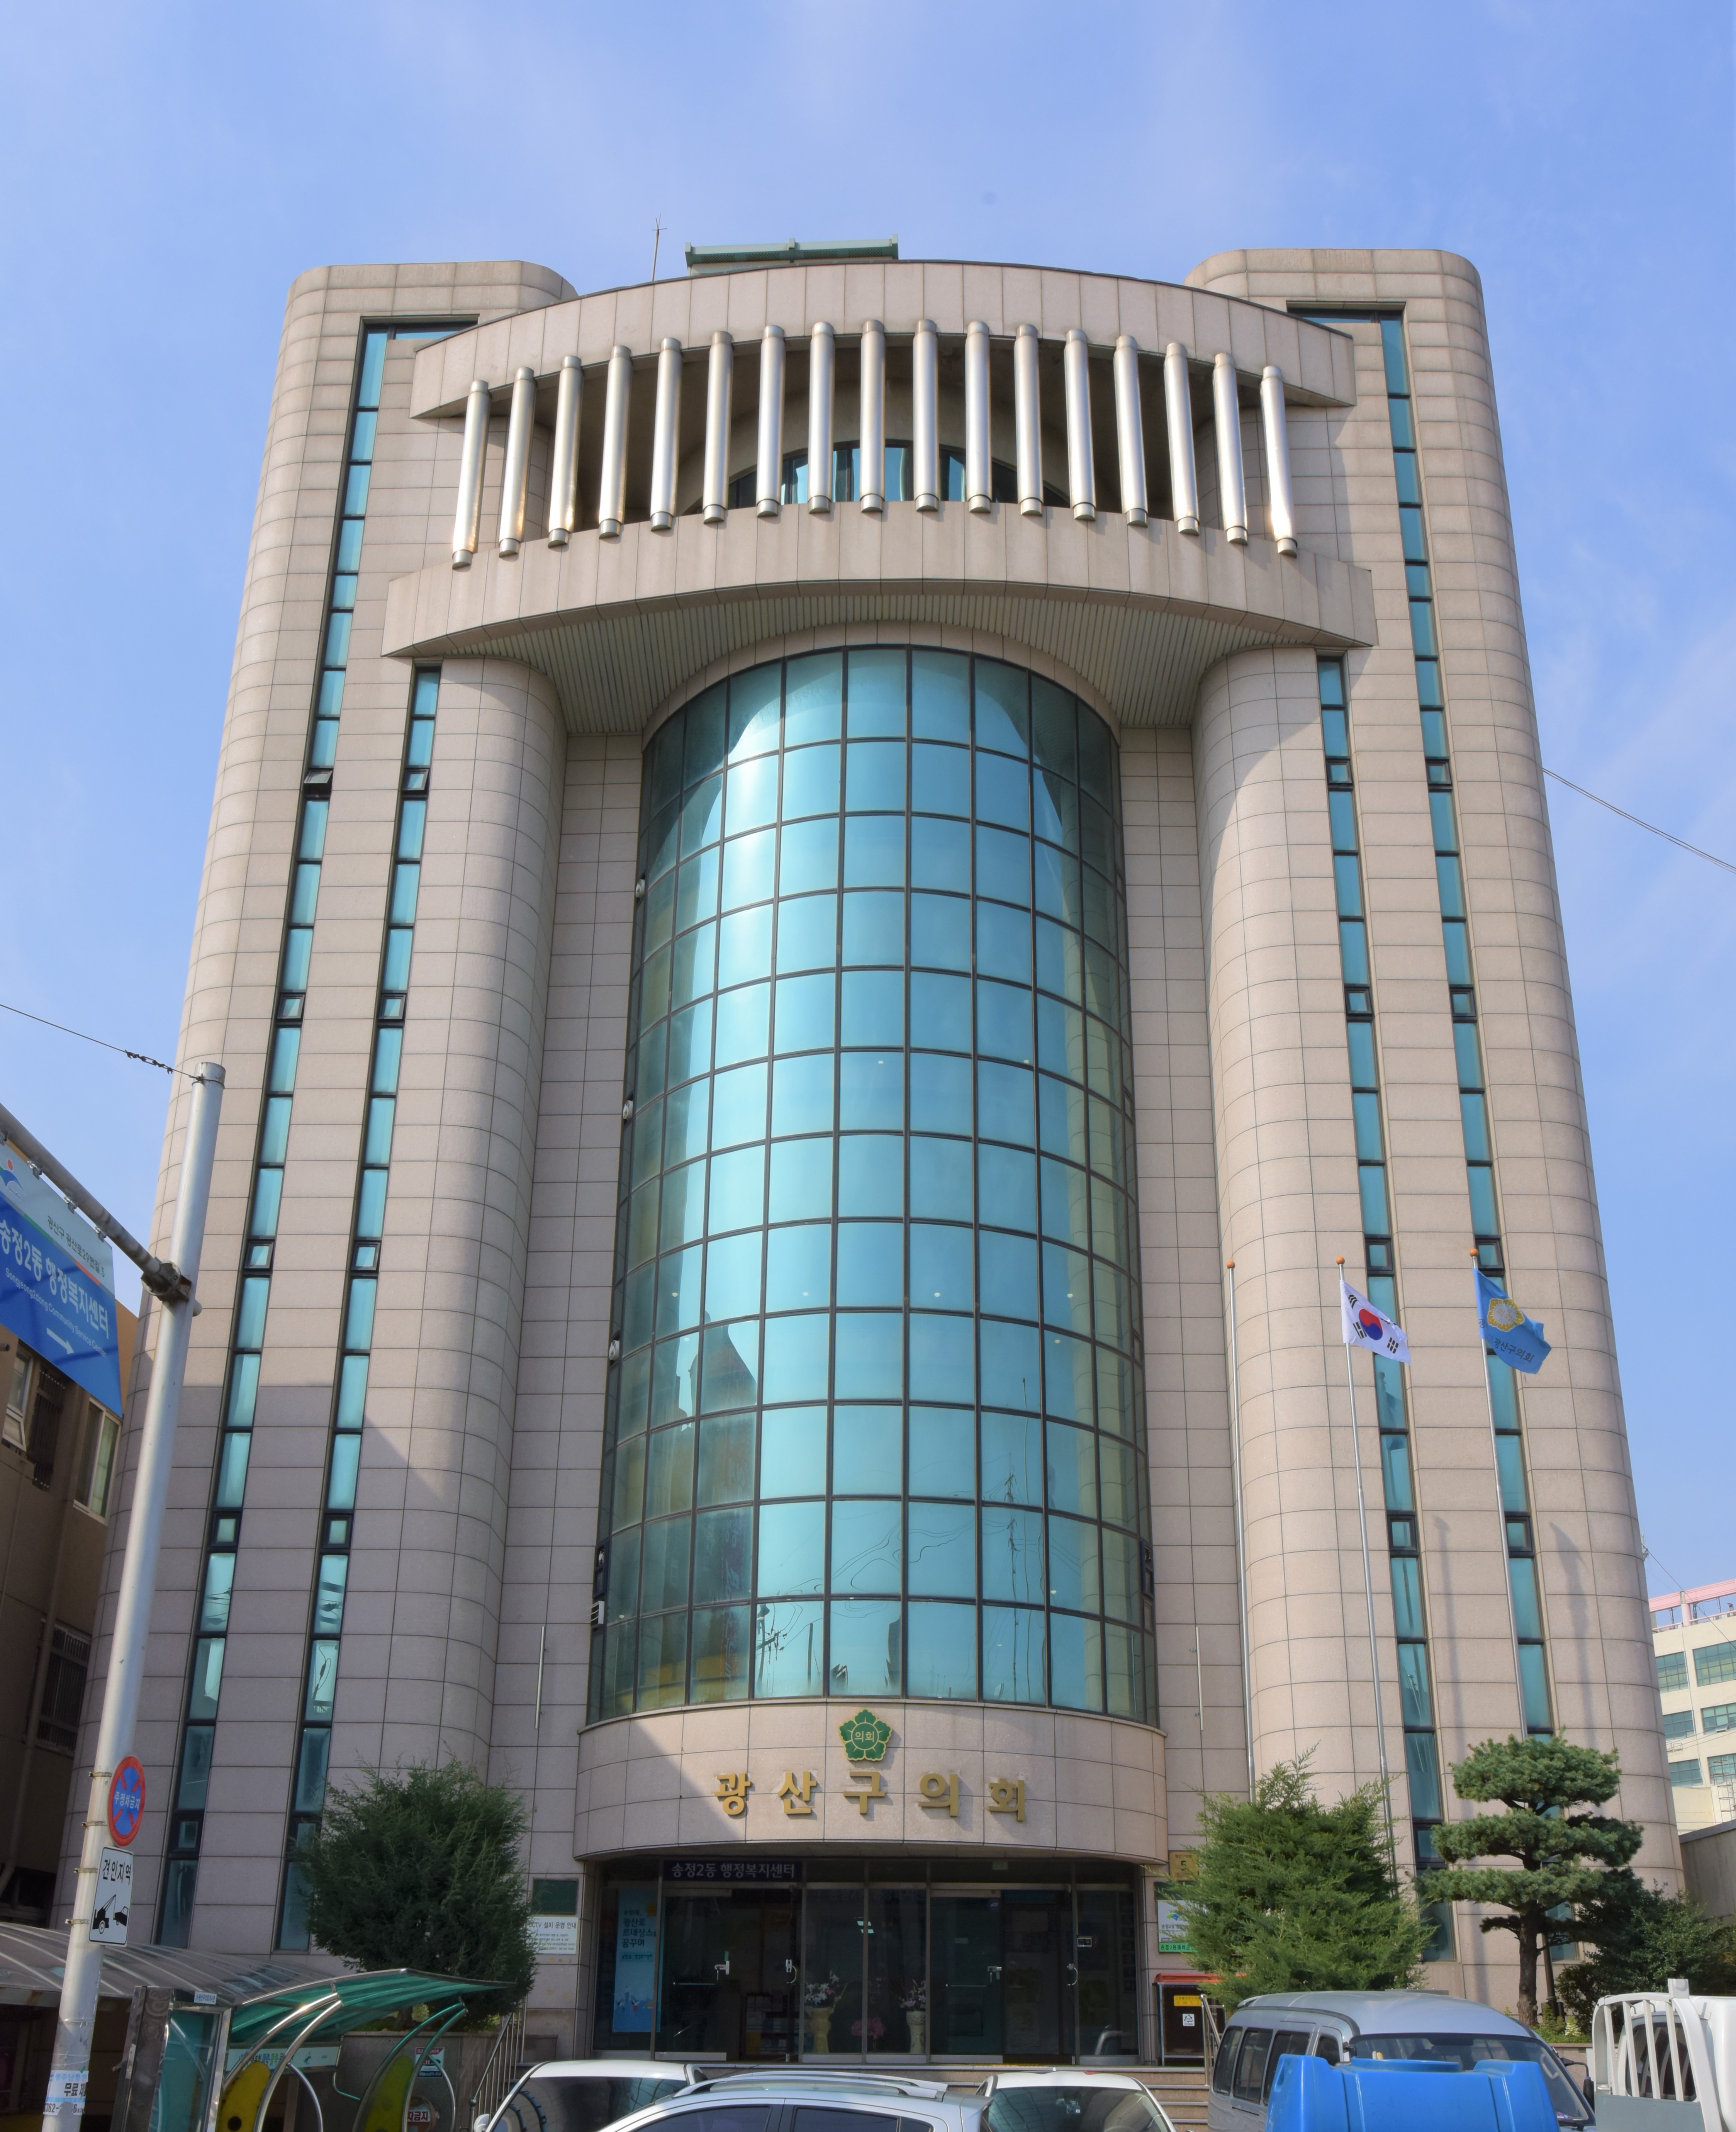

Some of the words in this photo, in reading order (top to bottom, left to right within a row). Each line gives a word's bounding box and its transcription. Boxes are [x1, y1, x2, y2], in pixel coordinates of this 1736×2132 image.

[48, 1215, 65, 1239] 광산구
[101, 1267, 105, 1278] 5
[0, 1219, 42, 1282] 송정2동
[46, 1256, 109, 1339] 행정복지센터
[5, 1267, 48, 1311] Songjeong2dong
[49, 1302, 75, 1333] Community
[75, 1326, 92, 1349] Service
[92, 1341, 107, 1358] Center
[1494, 1338, 1534, 1363] 광산구의회
[854, 1731, 876, 1743] 의회
[114, 1791, 141, 1811] 주정차금지
[714, 1771, 1026, 1821] 광산구의회
[102, 1858, 132, 1886] 견인지역
[671, 1863, 717, 1878] 송정2동
[720, 1863, 795, 1879] 행정복지센터
[623, 1918, 646, 1927] 광산로
[622, 1938, 645, 1948] 꿈꾸며
[64, 2083, 79, 2097] 무료
